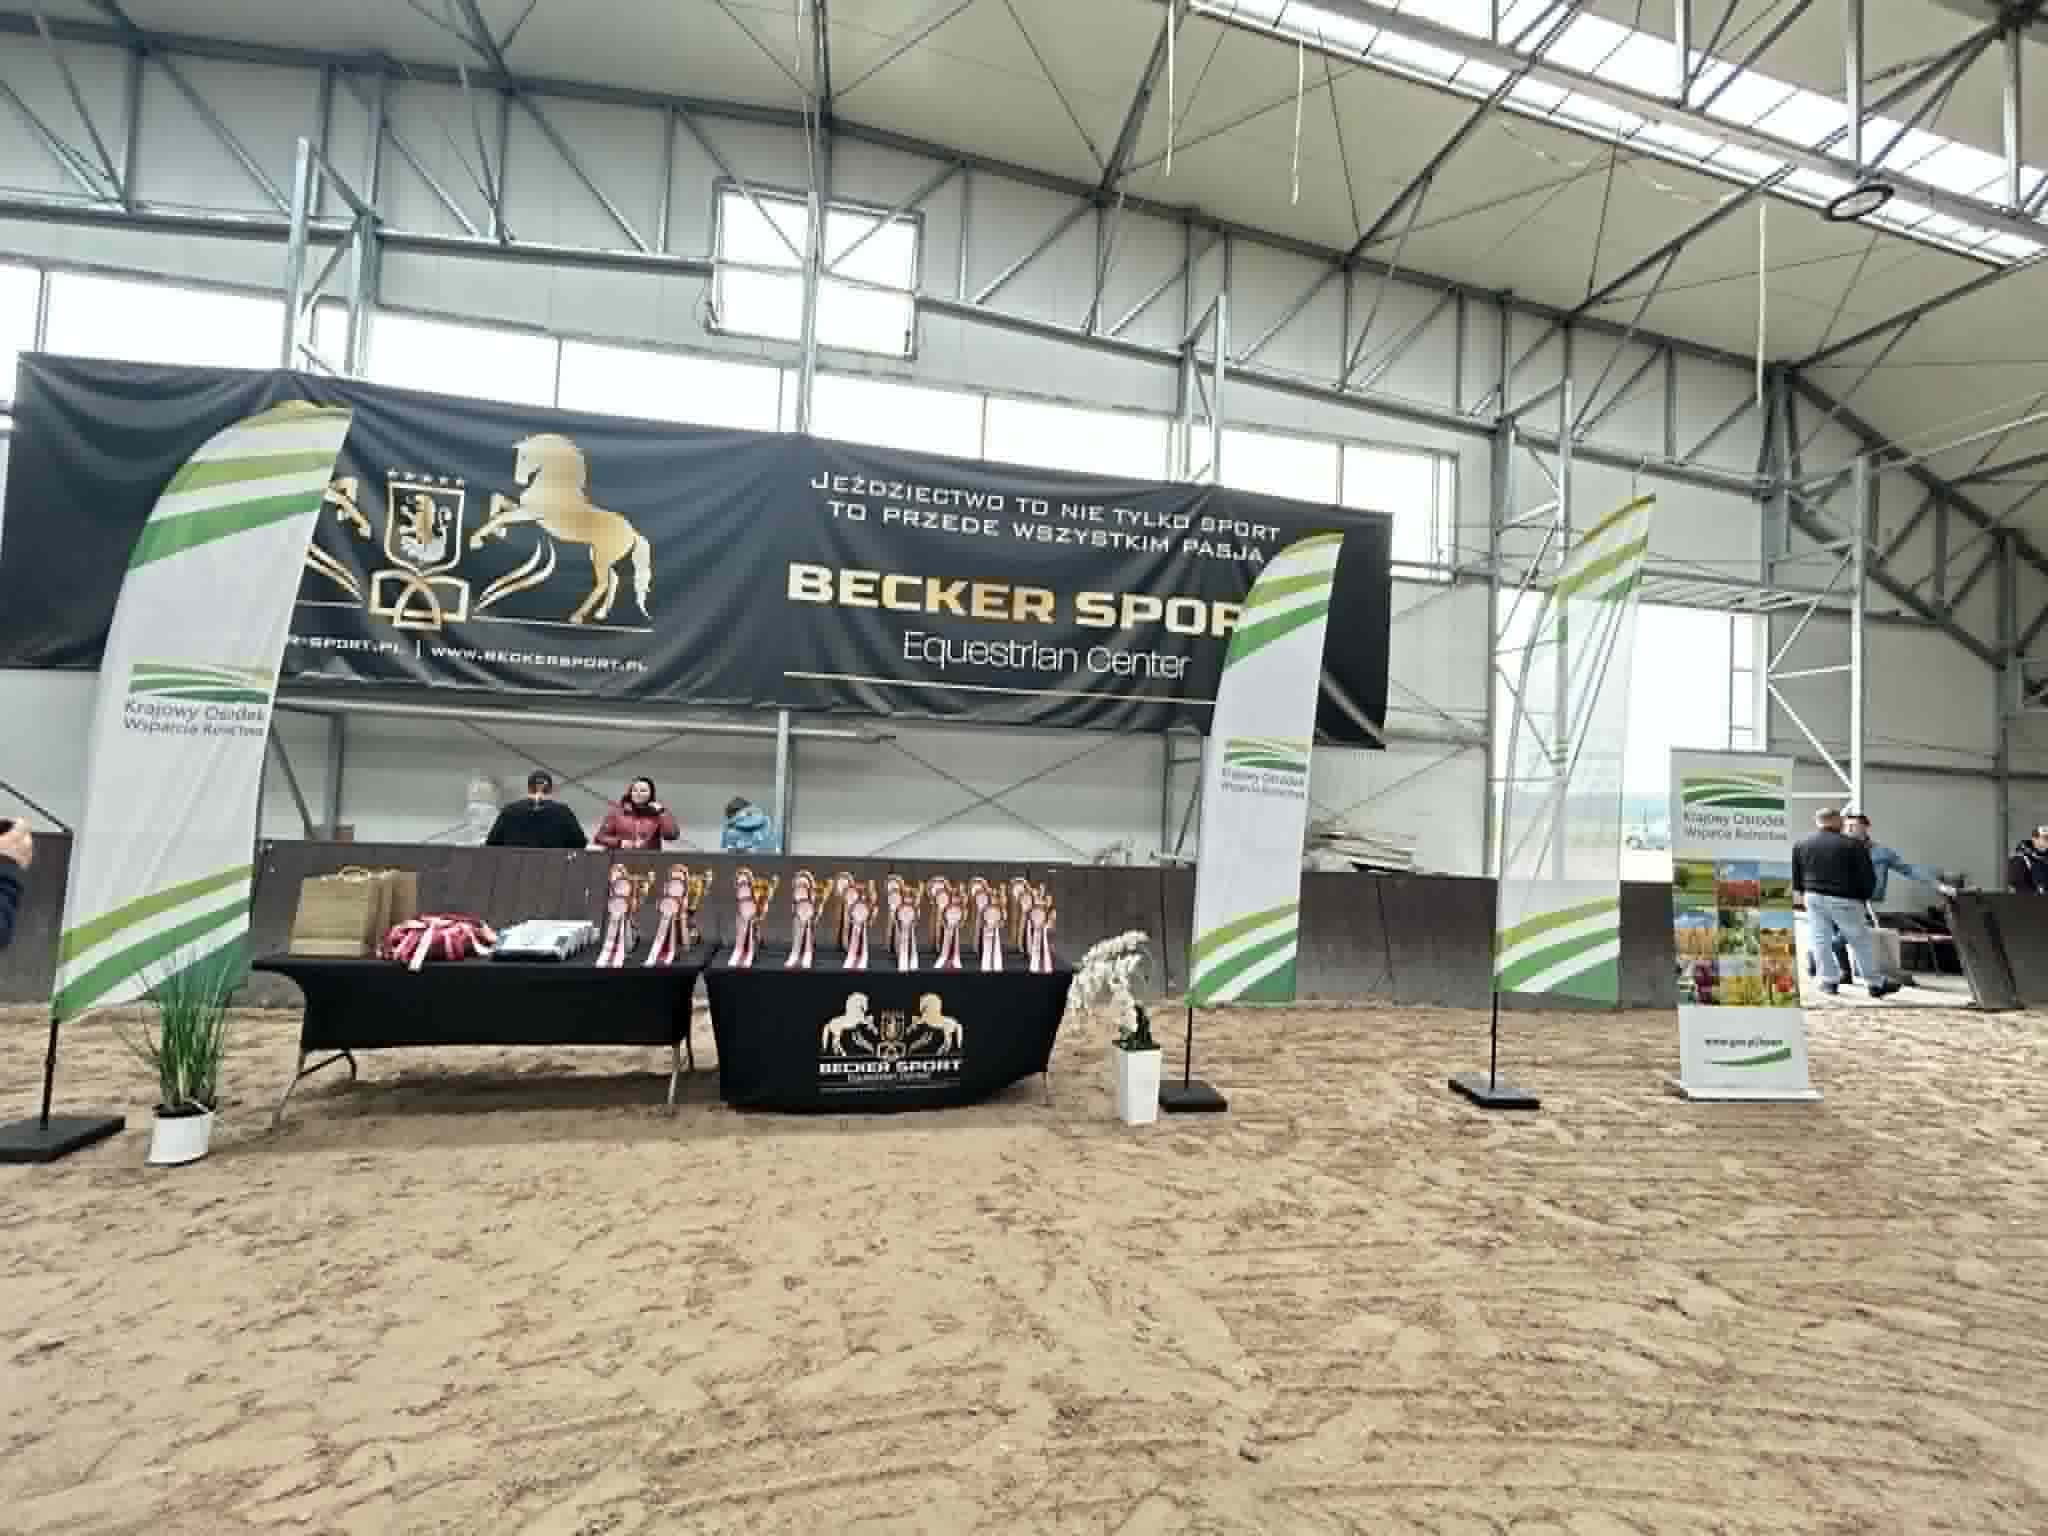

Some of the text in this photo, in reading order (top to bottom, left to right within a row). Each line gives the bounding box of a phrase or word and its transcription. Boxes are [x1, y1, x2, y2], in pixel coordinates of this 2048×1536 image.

[826, 500, 867, 521] TO
[882, 505, 1000, 537] PRZEDE
[1012, 521, 1169, 553] WSZYSTKIM
[1015, 496, 1049, 516] TO
[1061, 503, 1105, 521] NIE
[1112, 508, 1190, 529] TYLKO
[1200, 516, 1281, 542] SPORT
[787, 561, 1248, 637] BECKER SPOR
[903, 631, 1192, 680] Equestrian Center
